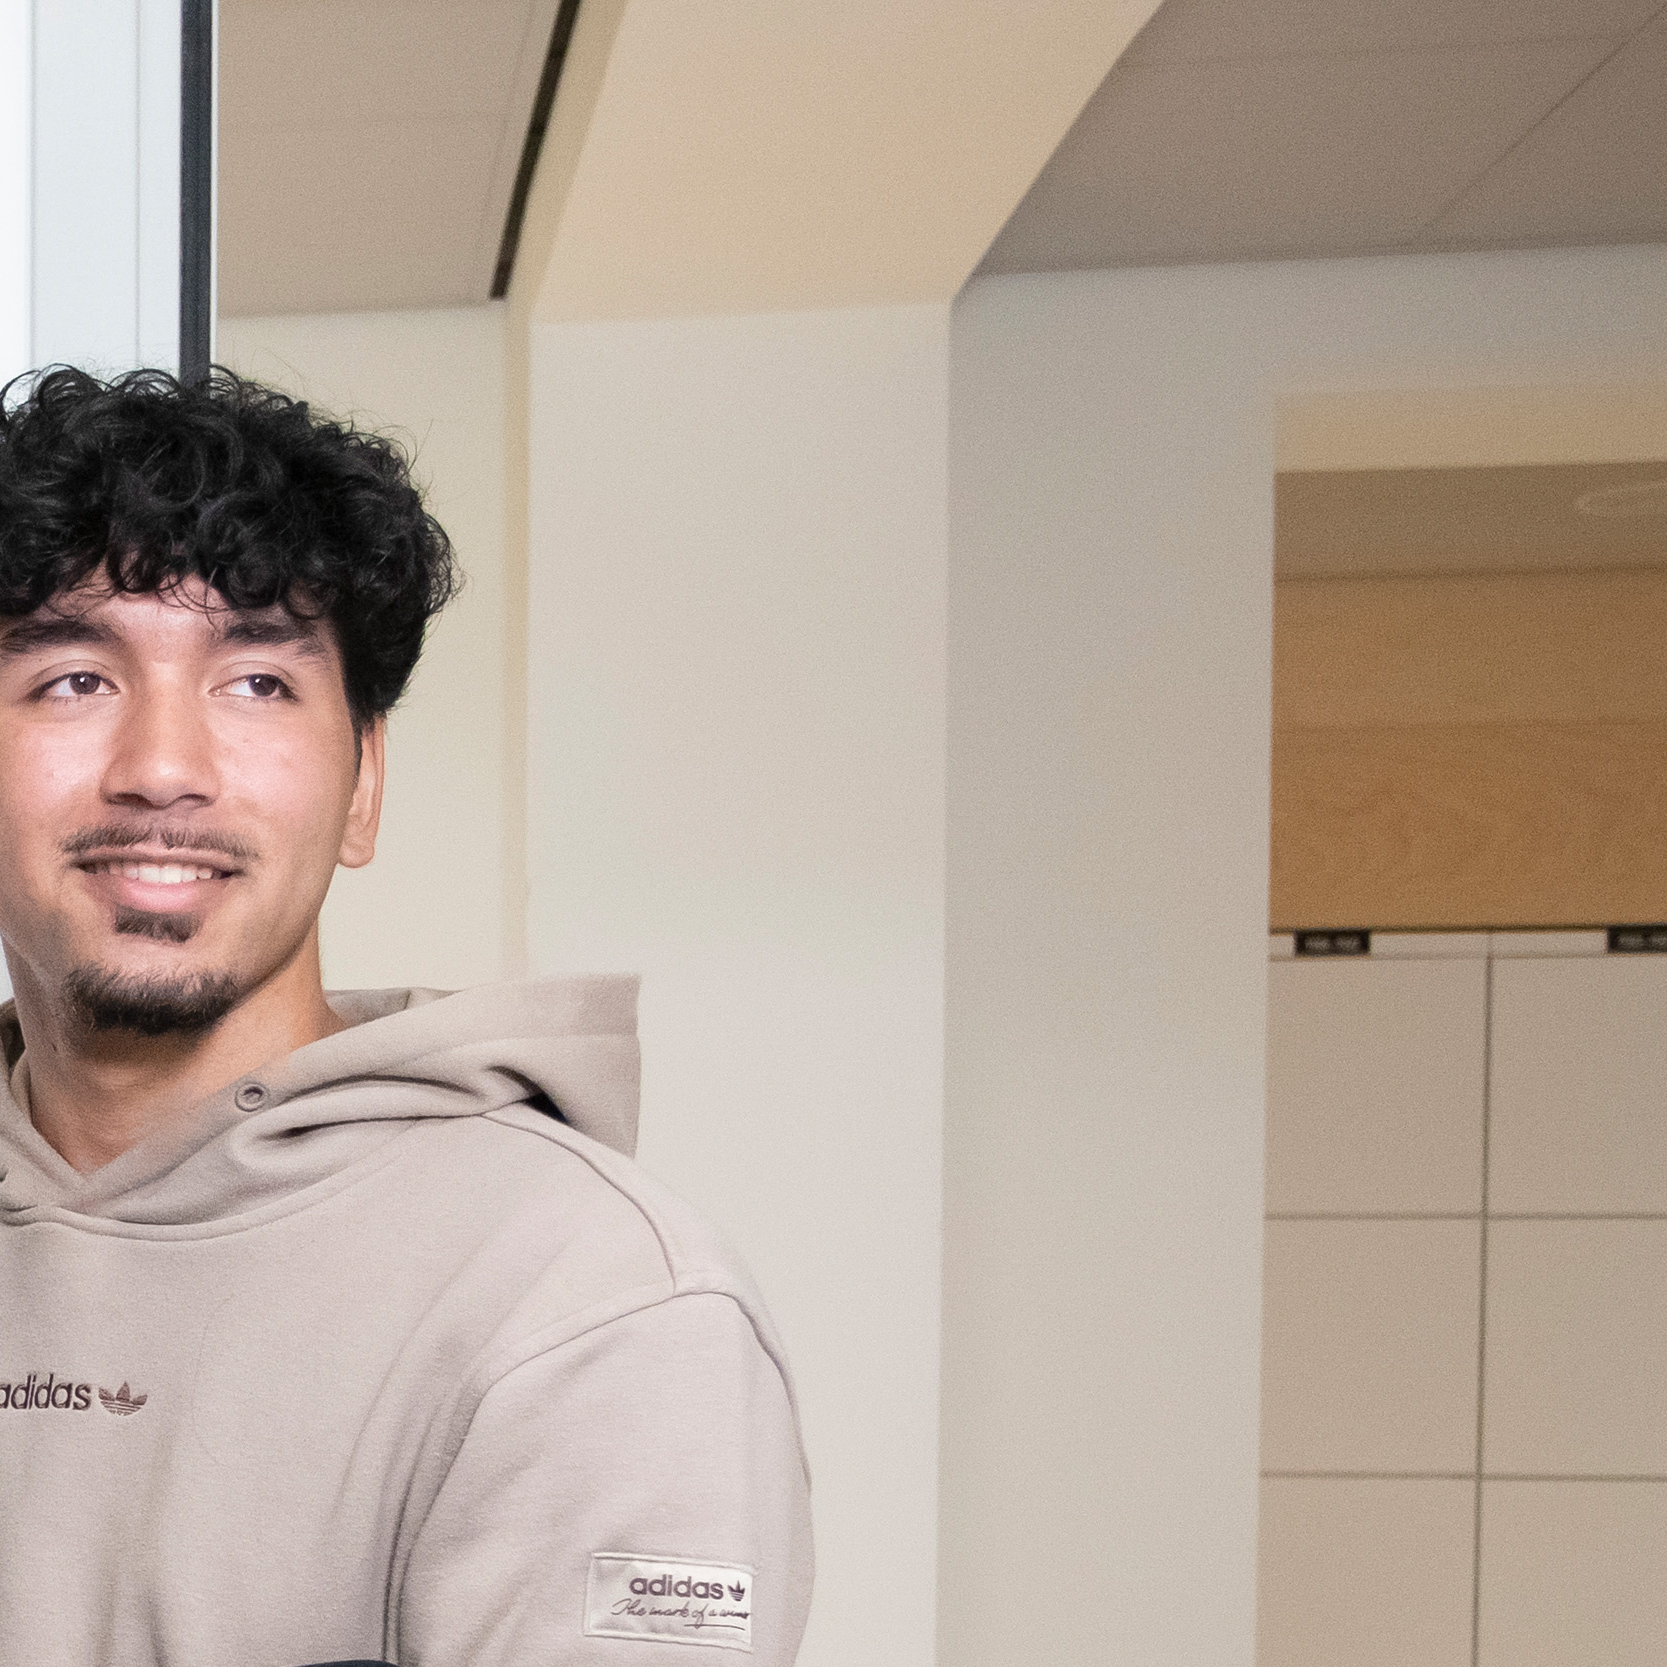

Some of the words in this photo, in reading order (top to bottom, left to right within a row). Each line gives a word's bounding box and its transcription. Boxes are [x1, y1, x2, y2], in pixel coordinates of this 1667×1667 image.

[629, 1574, 724, 1600] adidas
[611, 1598, 647, 1617] The
[649, 1601, 690, 1618] mark
[691, 1603, 709, 1626] of
